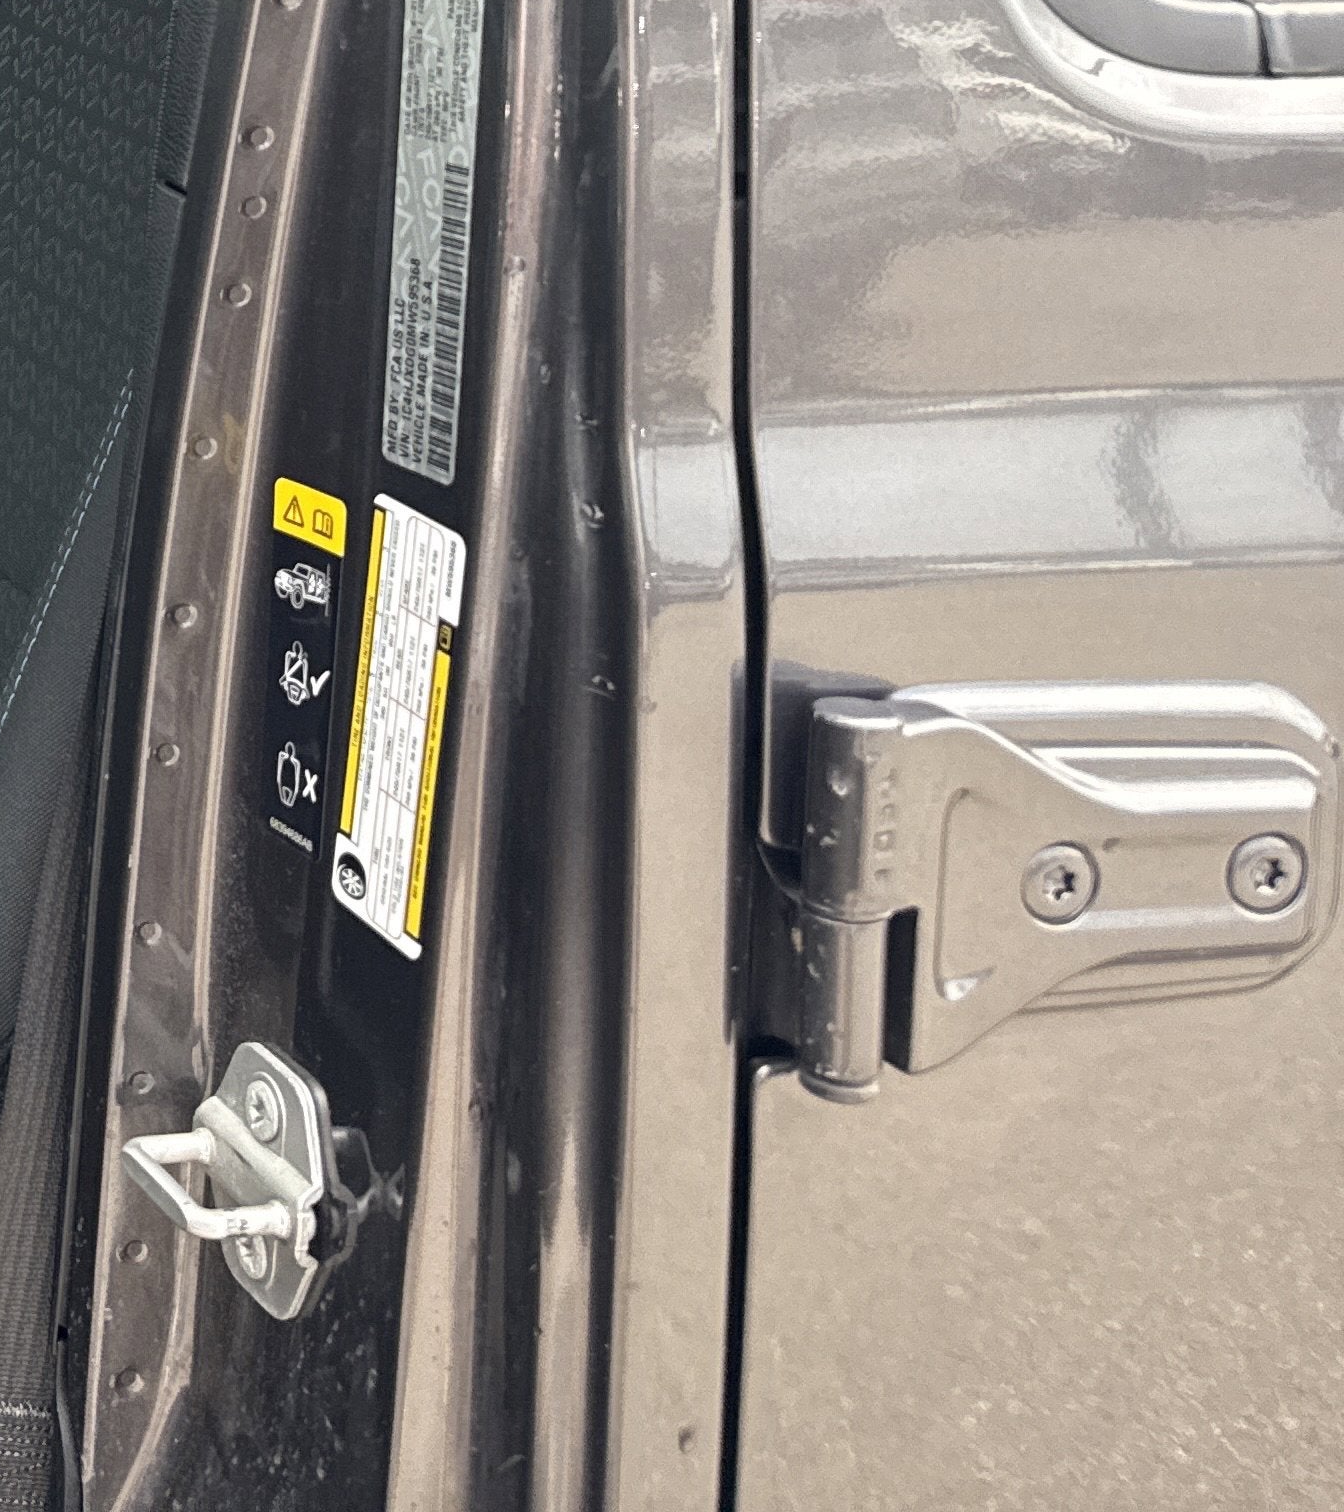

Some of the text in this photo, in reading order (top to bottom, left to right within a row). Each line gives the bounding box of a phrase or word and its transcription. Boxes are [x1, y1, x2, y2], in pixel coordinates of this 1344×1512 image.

[393, 297, 404, 324] LLC
[392, 328, 402, 348] US
[390, 354, 401, 382] FCA
[415, 353, 427, 396] MADE
[387, 419, 397, 453] MFD
[412, 401, 424, 463] VEHICLE
